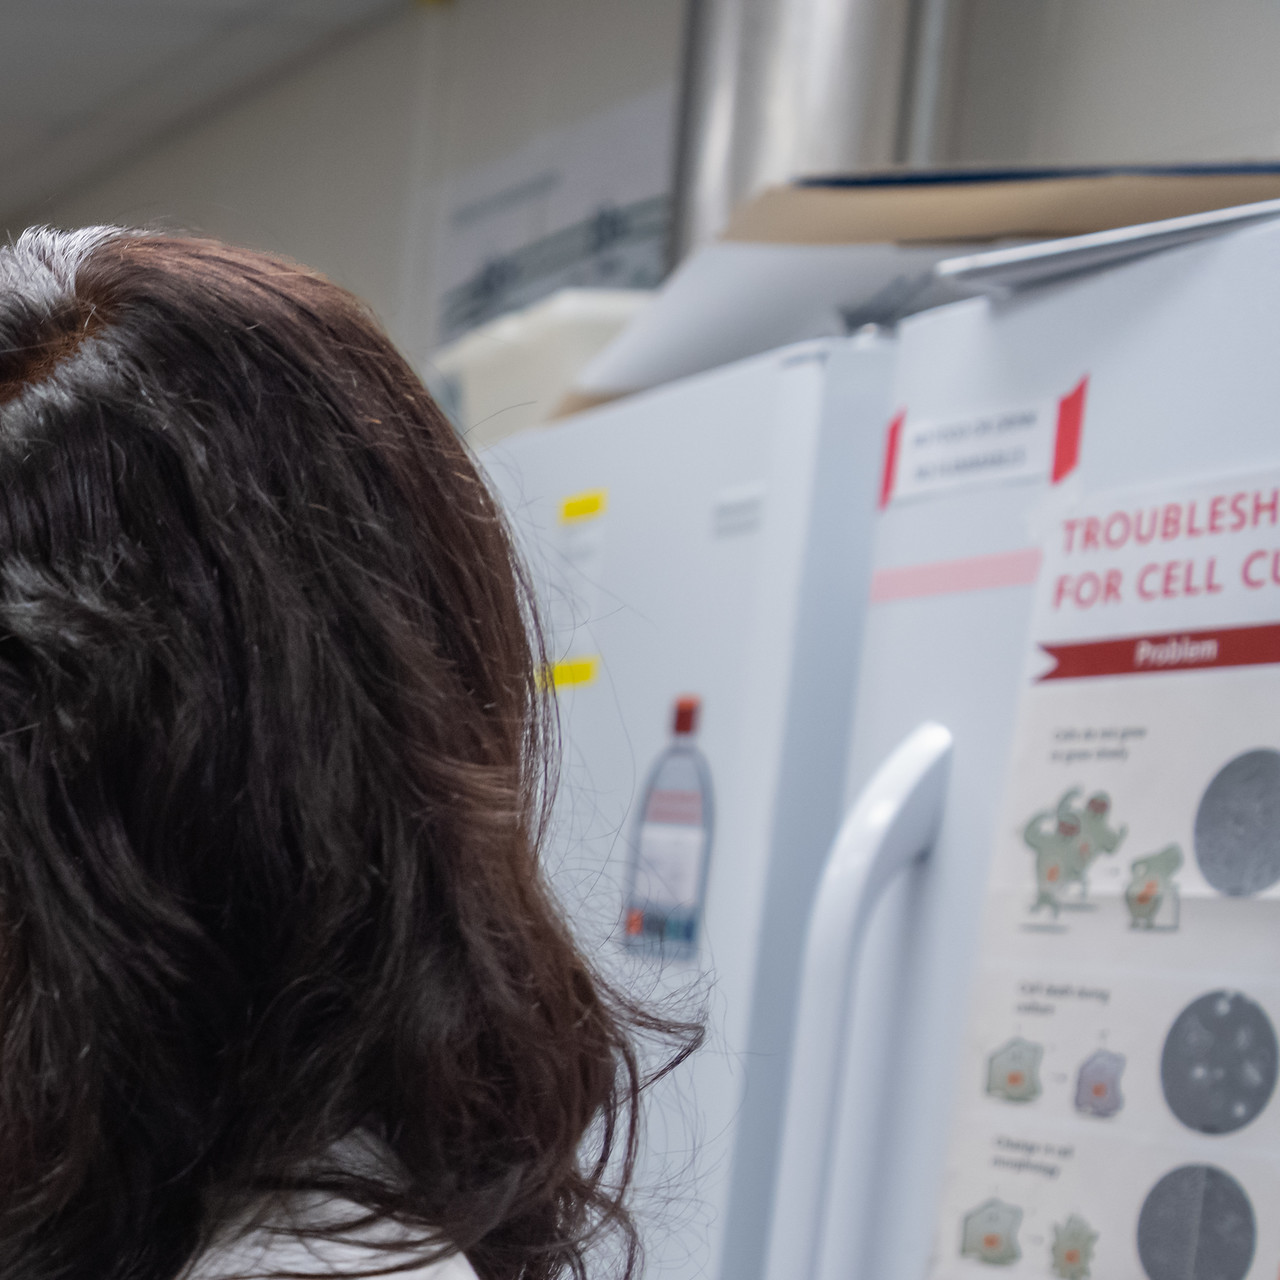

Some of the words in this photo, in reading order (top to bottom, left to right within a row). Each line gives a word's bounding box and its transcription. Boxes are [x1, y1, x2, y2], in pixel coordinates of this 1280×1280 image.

[1052, 568, 1124, 611] FOR
[1136, 556, 1223, 602] CELL
[1134, 633, 1219, 667] Problem
